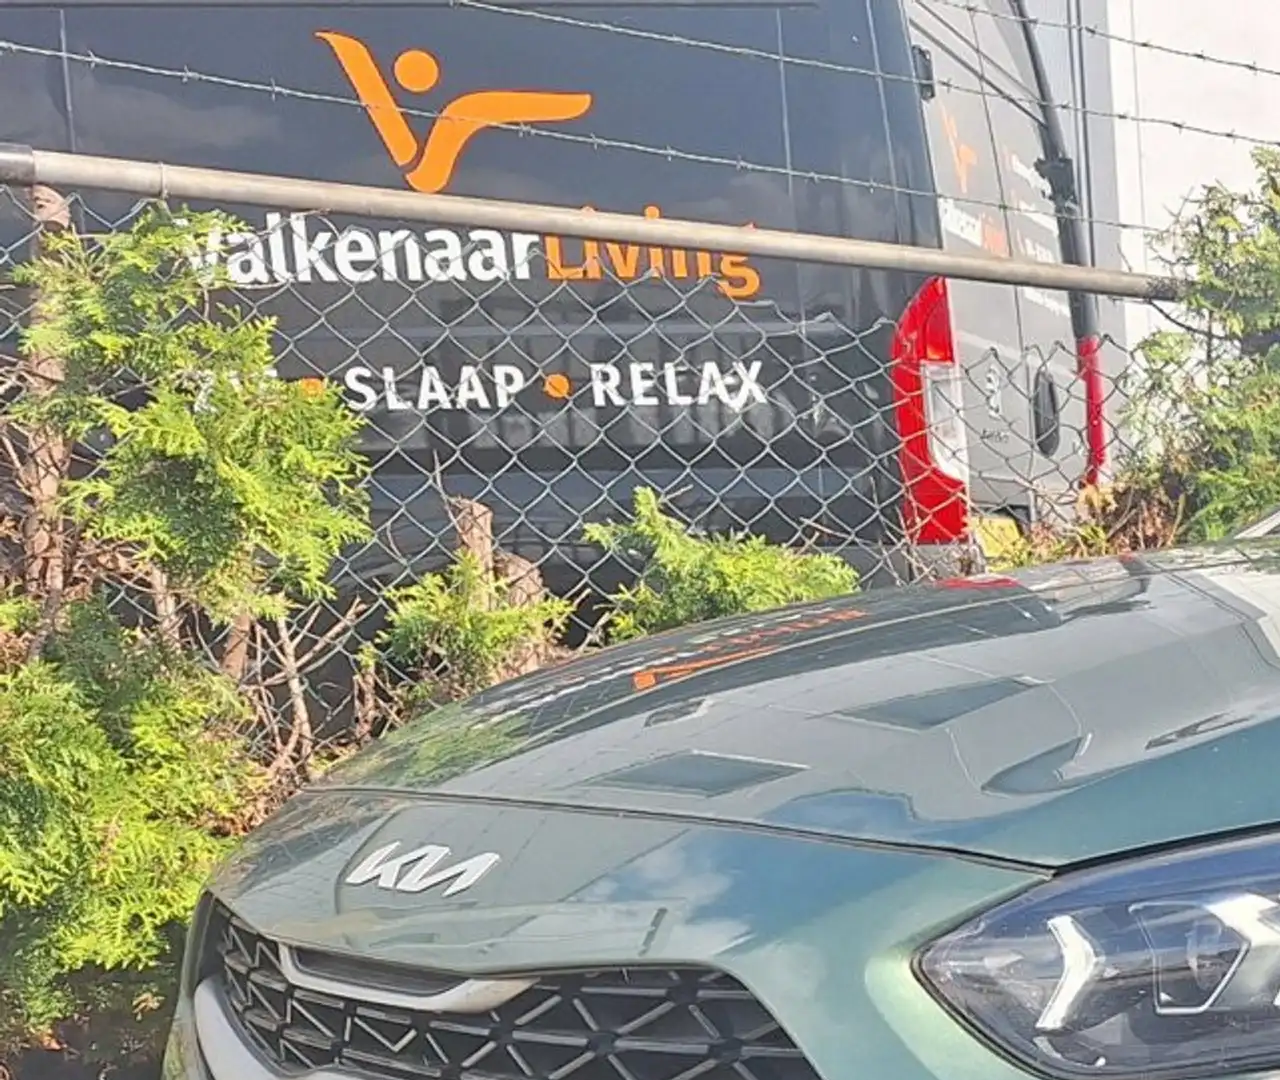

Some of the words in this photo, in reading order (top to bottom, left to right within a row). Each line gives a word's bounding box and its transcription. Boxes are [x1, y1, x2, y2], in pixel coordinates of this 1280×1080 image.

[344, 365, 525, 412] SLAAP
[590, 360, 768, 408] RELAX
[345, 840, 501, 899] KIA
